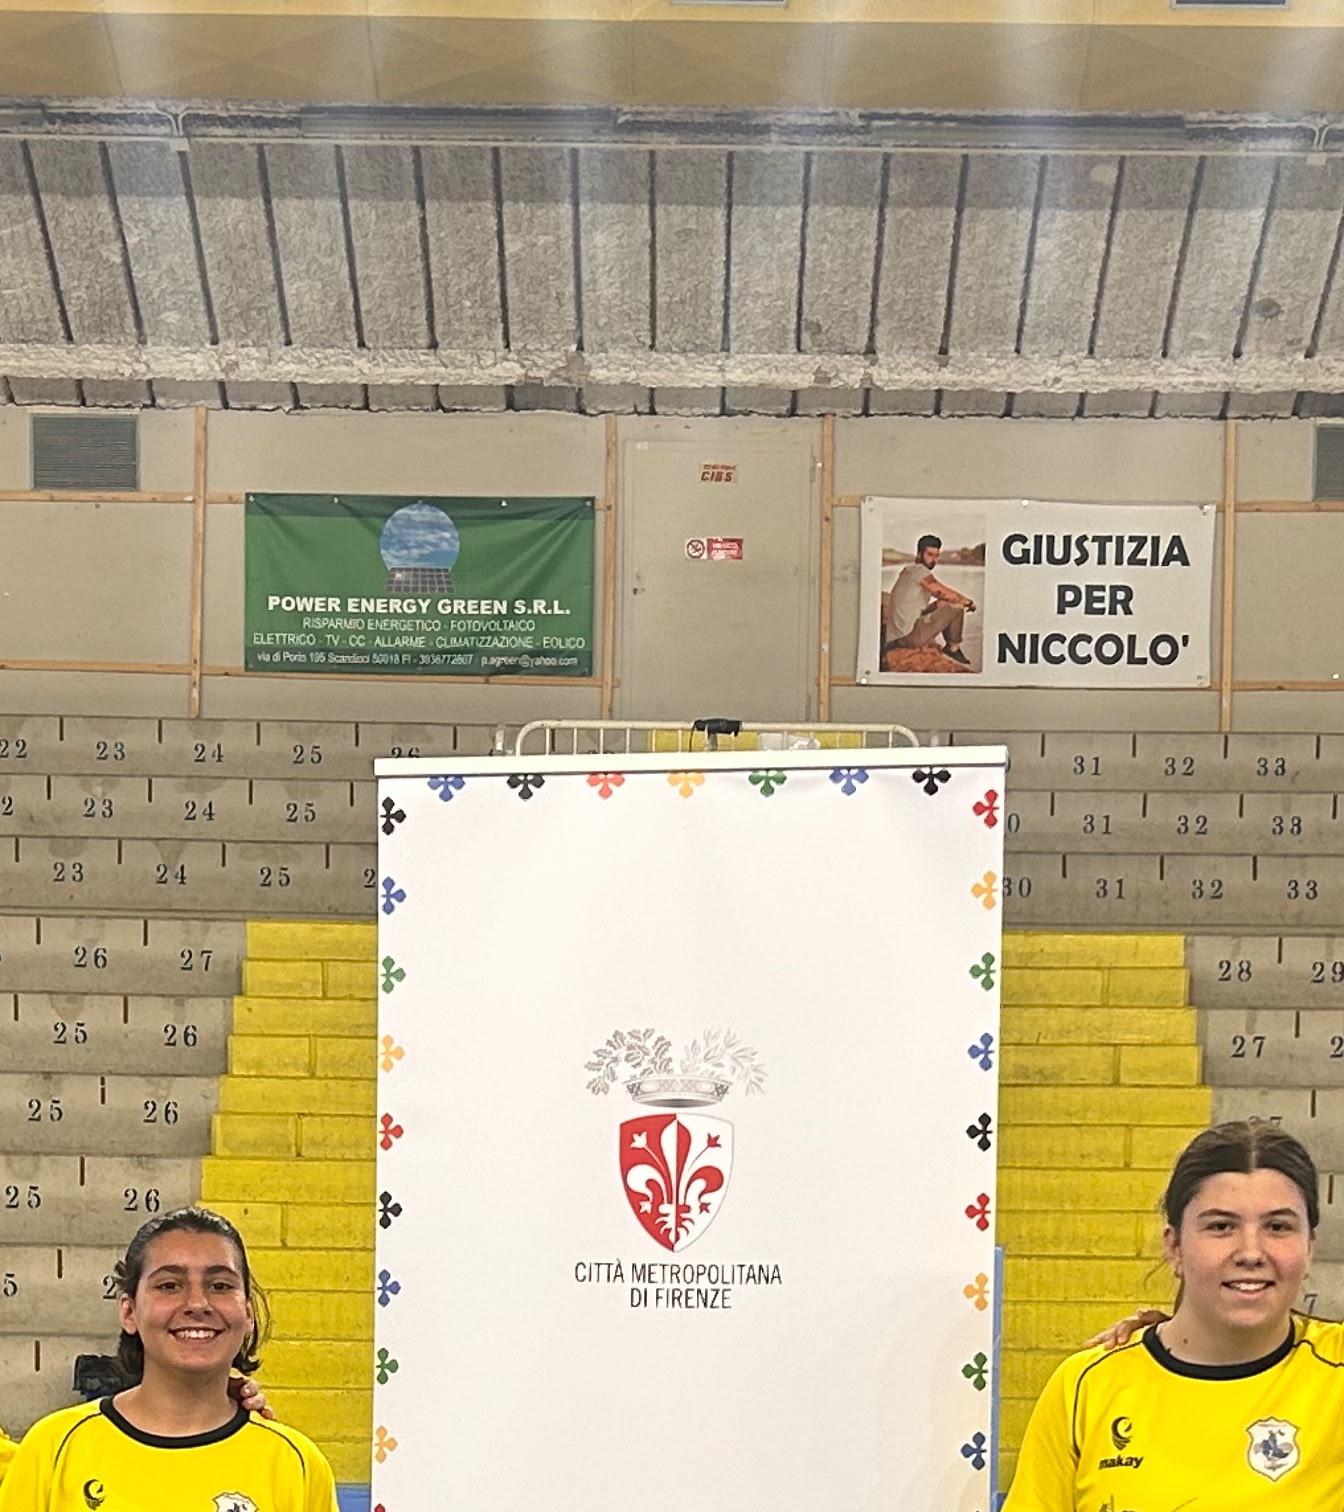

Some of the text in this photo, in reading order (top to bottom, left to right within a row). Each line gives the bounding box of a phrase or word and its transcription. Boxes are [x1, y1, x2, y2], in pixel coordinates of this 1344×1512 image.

[1002, 534, 1190, 567] GIUSTIZIA
[268, 596, 571, 615] POWER ENERGY GREEN S.R.L.
[1057, 585, 1133, 616] PER
[303, 617, 536, 632] RISPARMIO ENERGETICO FOTOVOLTAICO
[253, 632, 585, 649] ELETTRICO TV CC ALLARME CLIMATIZZAZIONE EOLICO
[997, 633, 1190, 666] NICCOLO'
[96, 741, 126, 761] 23
[1073, 755, 1101, 776] 31
[183, 800, 215, 821] 24
[1176, 814, 1208, 836] 32
[259, 866, 291, 888] 25
[73, 946, 108, 969] 26
[53, 1022, 88, 1045] 25
[143, 1100, 178, 1125] 26
[575, 1258, 782, 1286] CITTÀ METROPOLITANA
[630, 1287, 731, 1309] DI FIRENZE
[1098, 1454, 1143, 1470] makay
